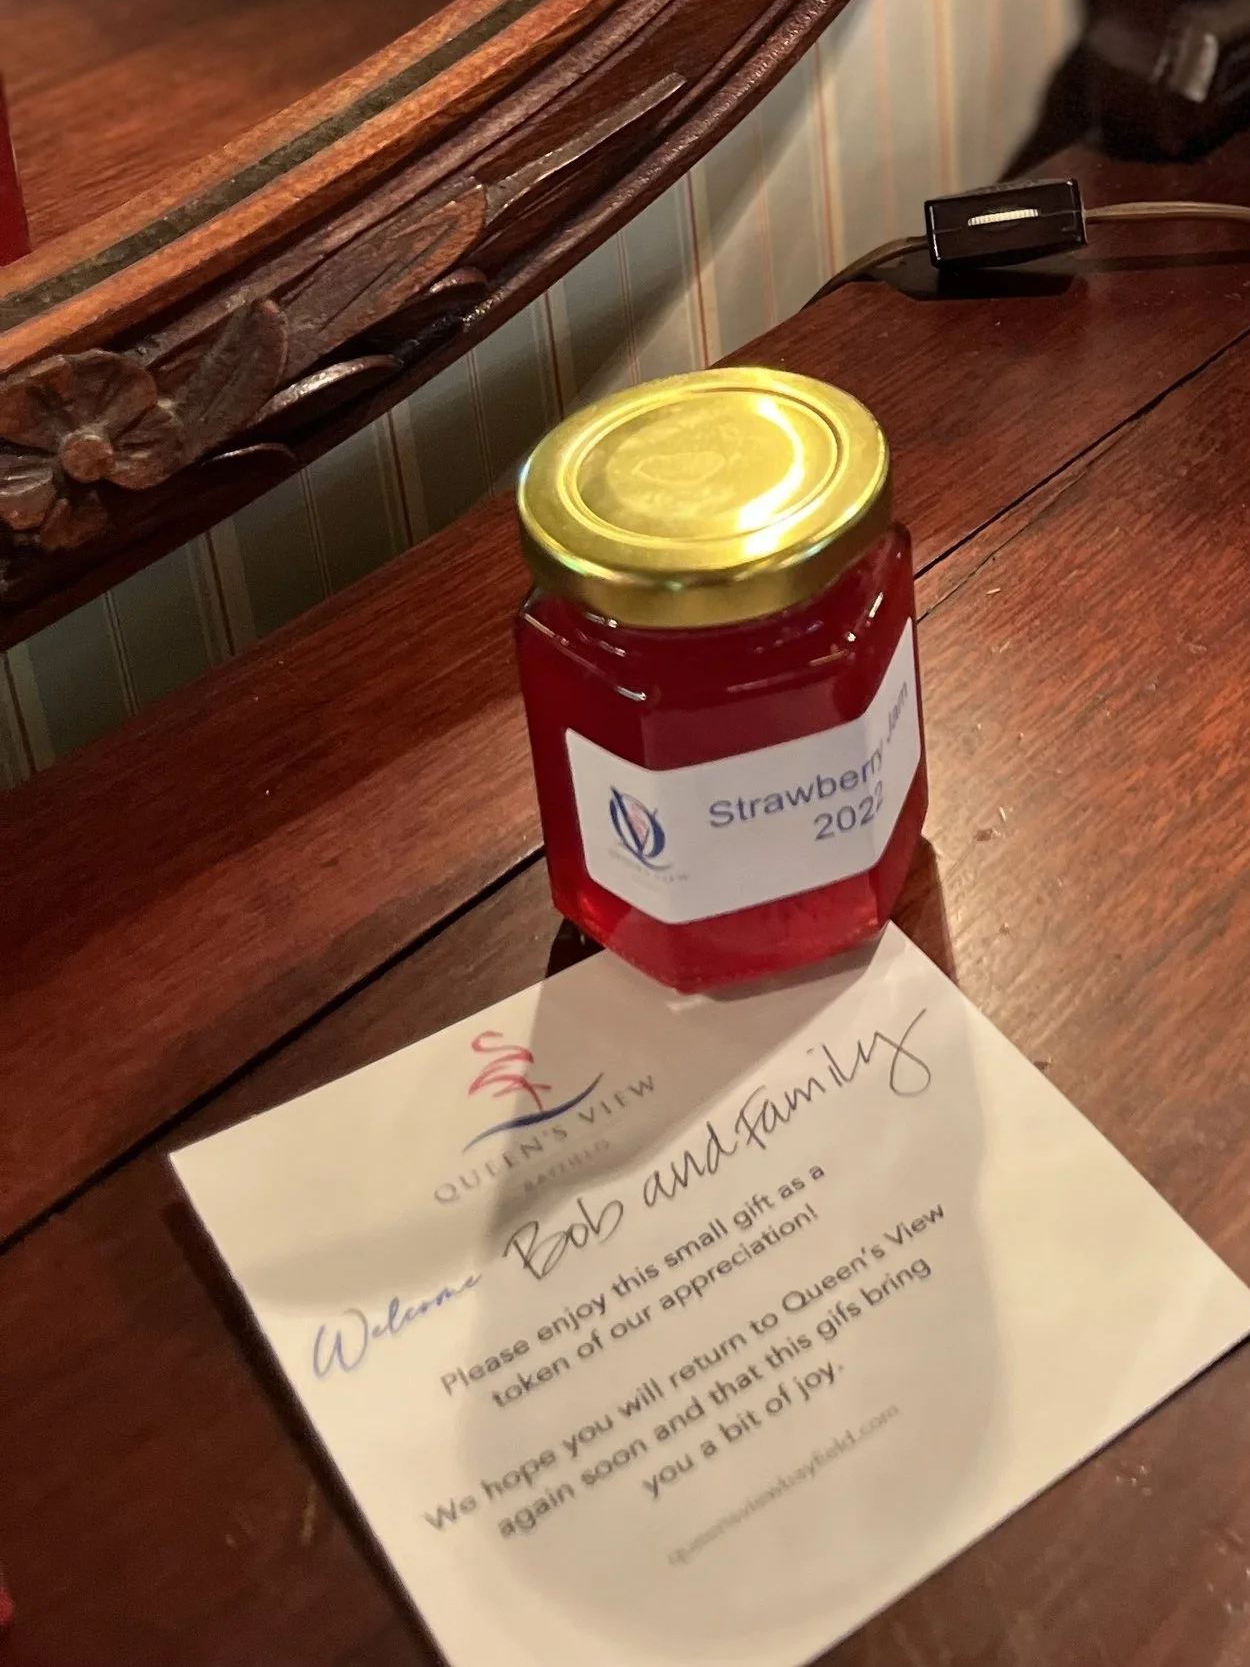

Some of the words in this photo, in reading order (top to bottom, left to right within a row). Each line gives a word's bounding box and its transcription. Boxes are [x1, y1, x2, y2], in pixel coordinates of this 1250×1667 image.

[814, 780, 883, 841] 2022
[312, 1273, 482, 1378] Welcome
[502, 1199, 624, 1280] Bob
[643, 1122, 736, 1208] and
[735, 1008, 931, 1150] Family
[439, 1339, 531, 1397] Please
[536, 1293, 607, 1345] enjoy
[610, 1264, 660, 1299] this
[663, 1217, 729, 1269] small
[732, 1193, 776, 1232] gift
[777, 1177, 806, 1201] as
[808, 1165, 826, 1182] a
[491, 1356, 572, 1409] token
[576, 1328, 604, 1361] of
[610, 1305, 652, 1341] our
[658, 1202, 819, 1312] appreciation!
[423, 1495, 478, 1532] We
[480, 1449, 558, 1501] hope
[561, 1414, 615, 1460] you
[617, 1377, 665, 1419] will
[668, 1333, 748, 1390] return
[748, 1312, 779, 1336] to
[781, 1244, 887, 1315] Queen's
[882, 1203, 945, 1246] View
[497, 1483, 576, 1539] again
[580, 1438, 649, 1487] soon
[653, 1395, 706, 1443] and
[707, 1364, 764, 1407] that
[764, 1333, 813, 1371] this
[815, 1300, 862, 1343] gifs
[858, 1258, 932, 1307] bring
[642, 1453, 696, 1501] you
[699, 1439, 719, 1460] a
[717, 1410, 763, 1445] bit
[764, 1382, 792, 1417] of
[792, 1361, 844, 1403] joy.
